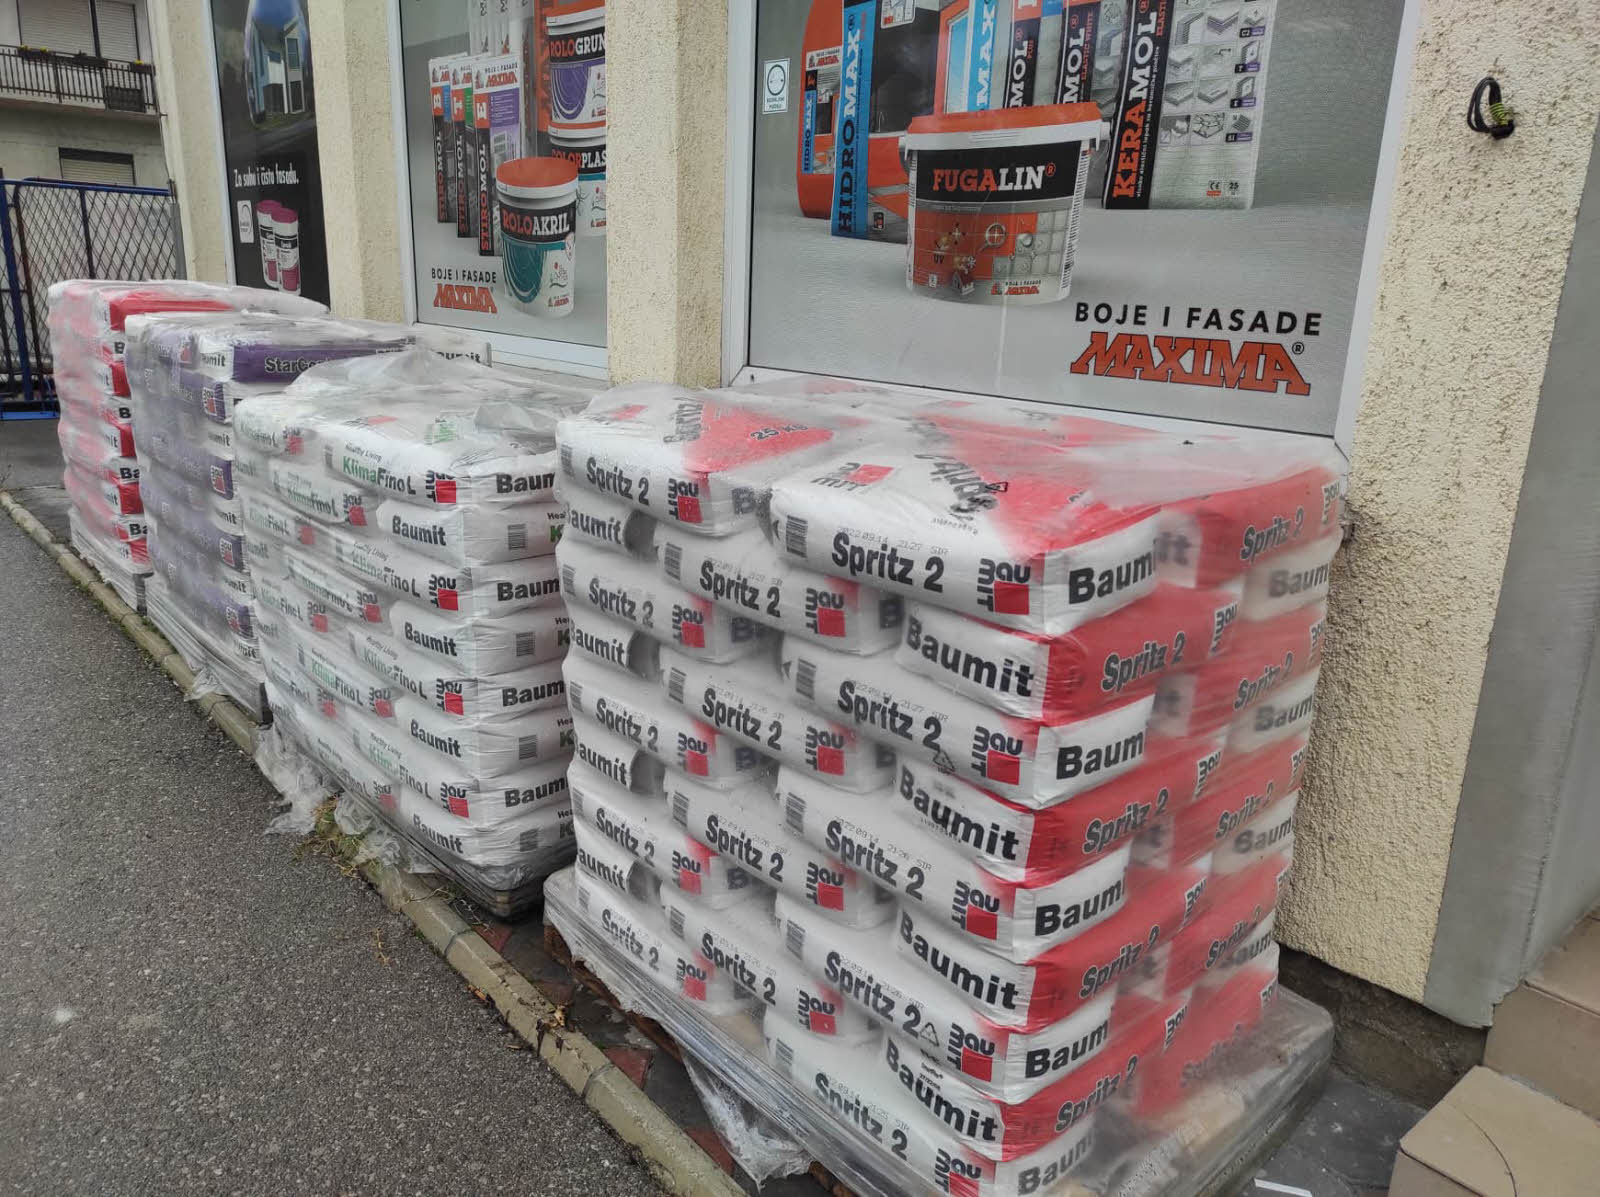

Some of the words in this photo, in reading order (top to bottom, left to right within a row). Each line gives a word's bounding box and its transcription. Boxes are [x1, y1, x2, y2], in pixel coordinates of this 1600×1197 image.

[234, 169, 243, 188] Za
[479, 143, 492, 251] STIROMOL
[502, 209, 570, 237] ROLOAKRIL
[431, 268, 453, 281] BOJE
[462, 271, 497, 284] FASADE
[1075, 302, 1148, 325] BOJE
[1162, 305, 1170, 327] I
[1186, 307, 1322, 336] FASADE
[751, 426, 780, 442] 25
[586, 456, 634, 501] Spritz
[638, 477, 650, 506] 2
[393, 515, 447, 546] Baumit
[1240, 519, 1290, 562] Spritz
[831, 531, 915, 586] Spritz
[923, 556, 945, 593] 2
[589, 577, 637, 622] Spritz
[642, 600, 655, 629] 2
[700, 560, 760, 611] Spritz
[766, 586, 781, 618] 2
[404, 622, 458, 657] Baumit
[905, 615, 1036, 697] Baumit
[1101, 640, 1169, 694] Spritz
[1234, 663, 1283, 711] Spritz
[410, 719, 462, 758] Baumit
[596, 697, 643, 745] Spritz
[647, 725, 659, 753] 2
[702, 687, 761, 741] Spritz
[767, 720, 782, 751] 2
[837, 679, 914, 741] Spritz
[922, 715, 943, 752] 2
[412, 813, 464, 855] Baumit
[898, 763, 1020, 862] Baumit
[1081, 803, 1152, 855] Spritz
[1215, 795, 1264, 841] Spritz
[644, 838, 655, 867] 2
[705, 814, 763, 872] Spritz
[769, 851, 784, 882] 2
[825, 819, 898, 888] Spritz
[904, 865, 925, 901] 2
[648, 947, 661, 971] 2
[701, 932, 757, 992] Spritz
[762, 976, 777, 1007] 2
[899, 910, 1020, 1011] Baumit
[1079, 942, 1141, 999] Spritz
[823, 950, 896, 1023] Spritz
[901, 1003, 922, 1040] 2
[885, 1037, 1000, 1142] Baumit
[1054, 1073, 1121, 1132] Spritz
[890, 1127, 908, 1162] 2
